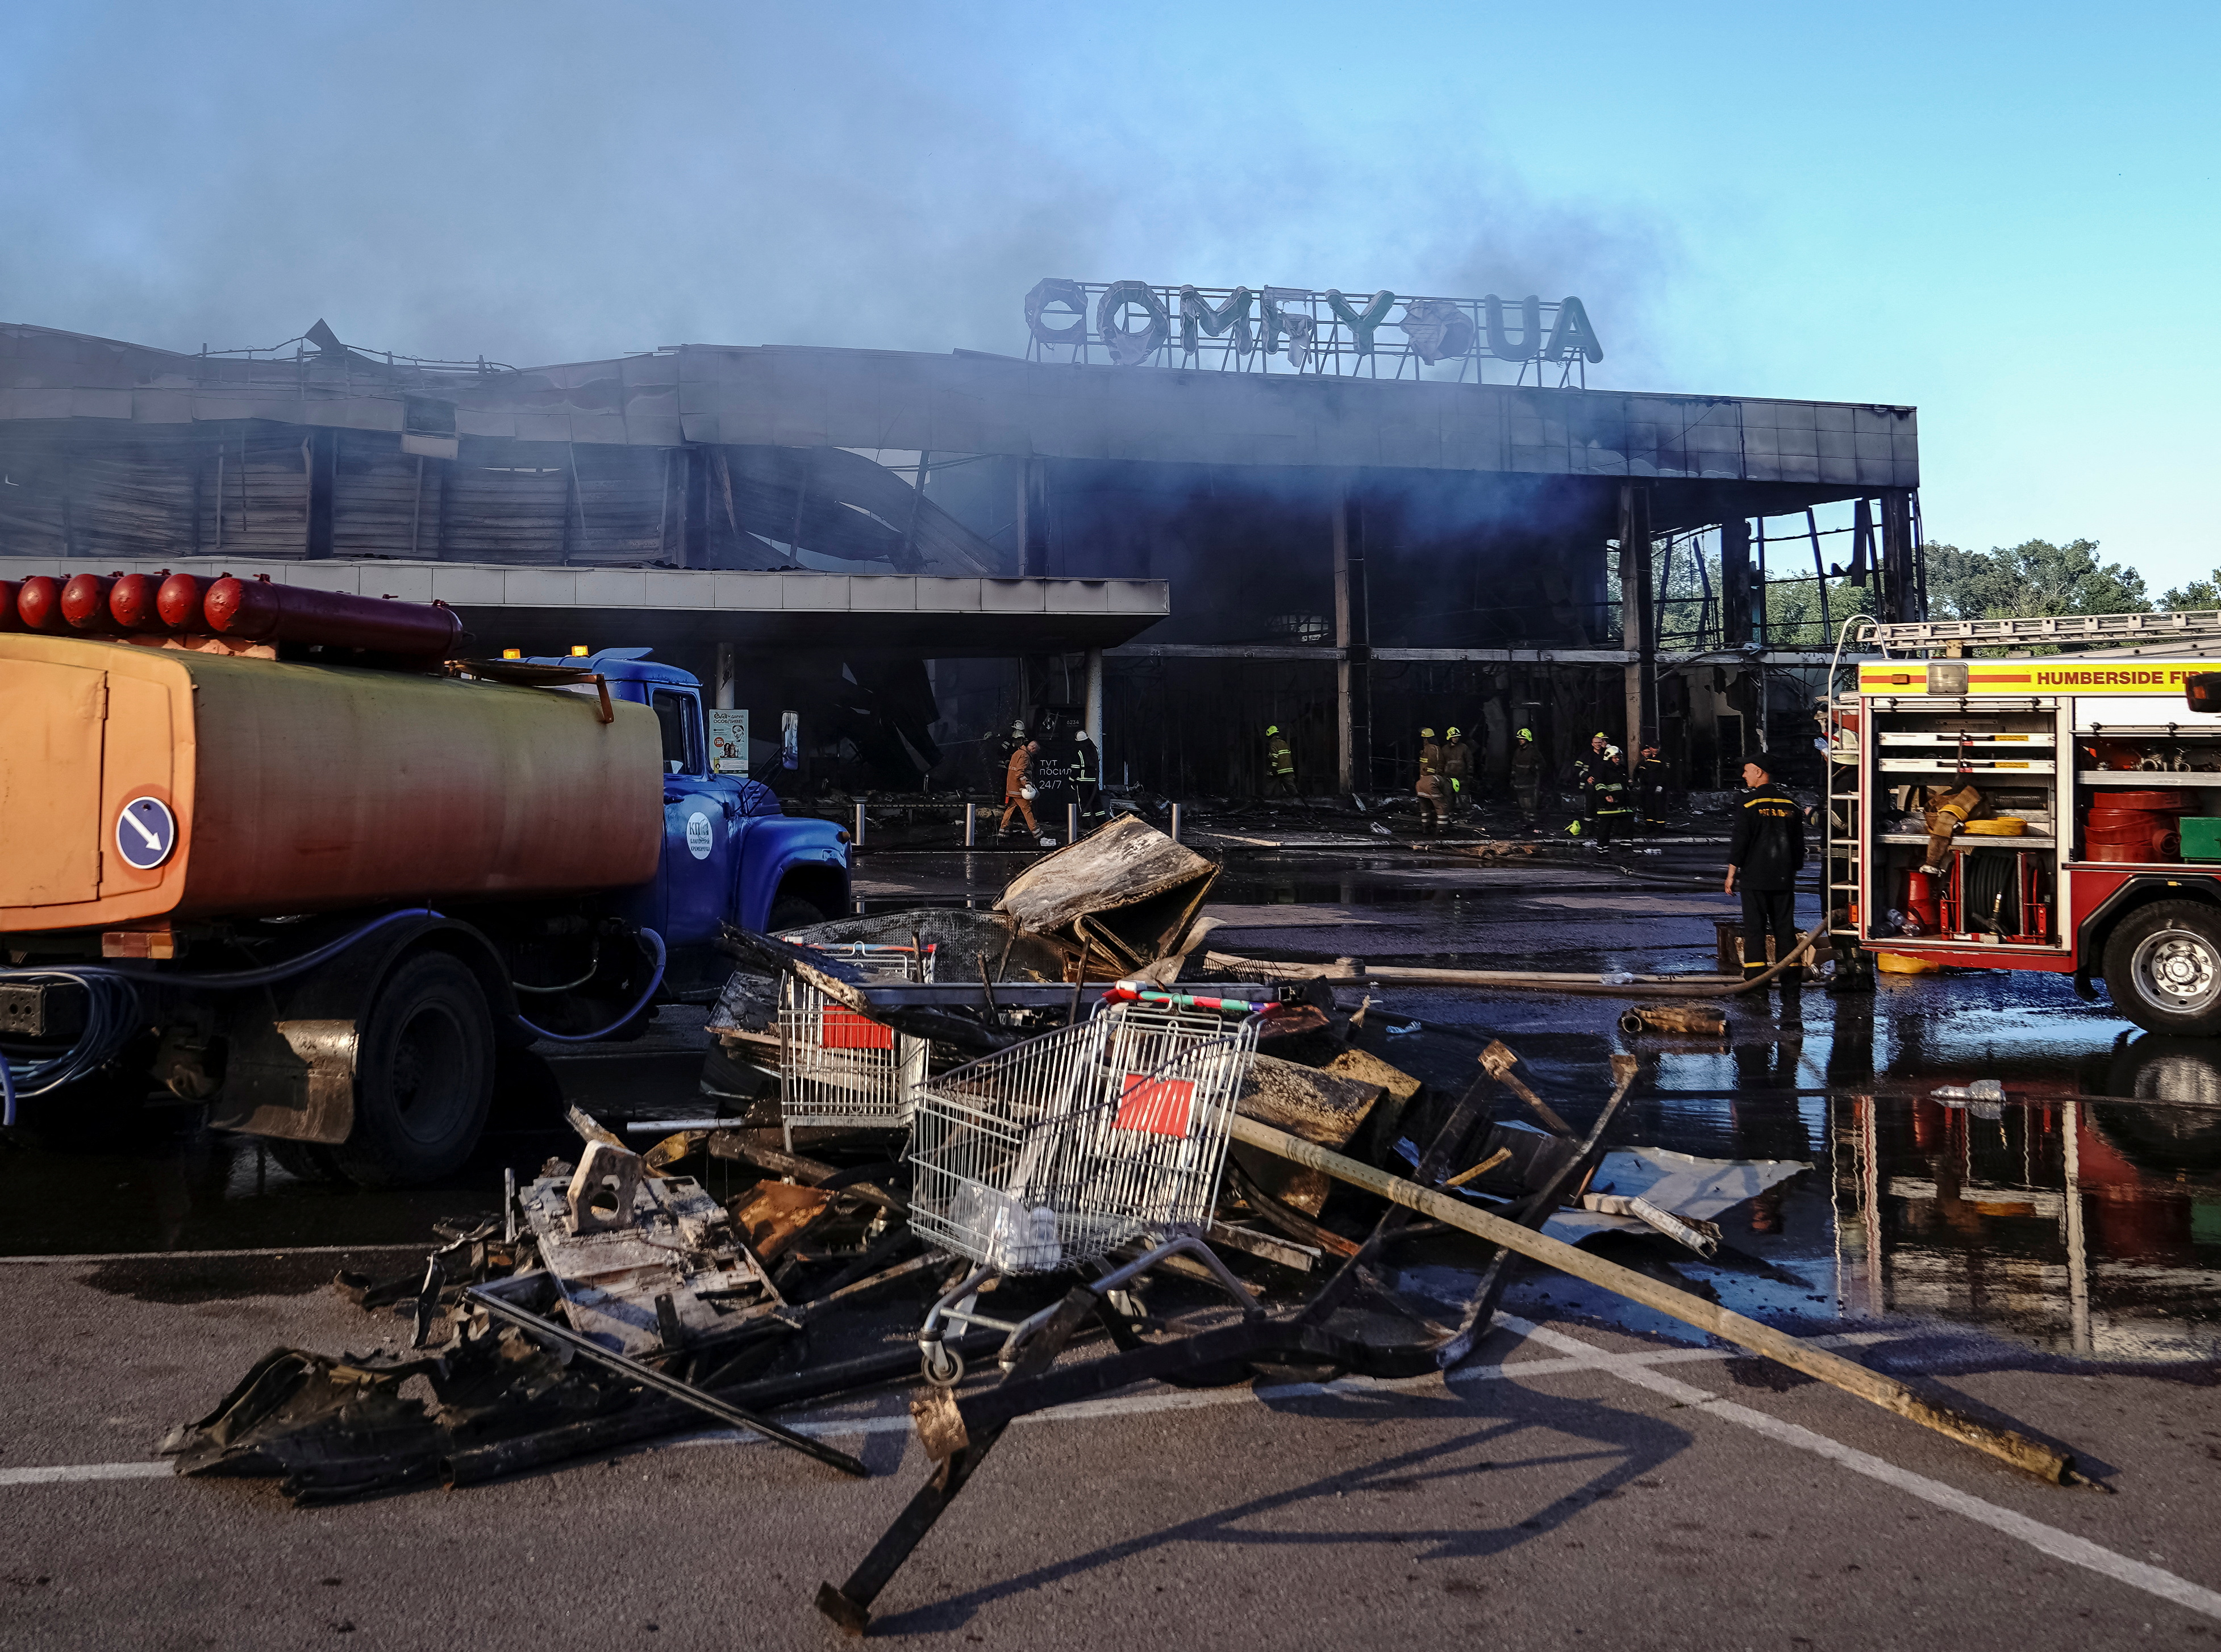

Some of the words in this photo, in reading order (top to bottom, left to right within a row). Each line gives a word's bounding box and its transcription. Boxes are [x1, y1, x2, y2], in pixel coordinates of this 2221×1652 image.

[1025, 278, 1395, 368] COMFY
[1484, 293, 1604, 364] UA
[2037, 671, 2164, 685] HUMBERSIDE
[2169, 671, 2214, 684] FI
[1040, 760, 1058, 768] ТУТ
[1039, 780, 1062, 790] 24/7
